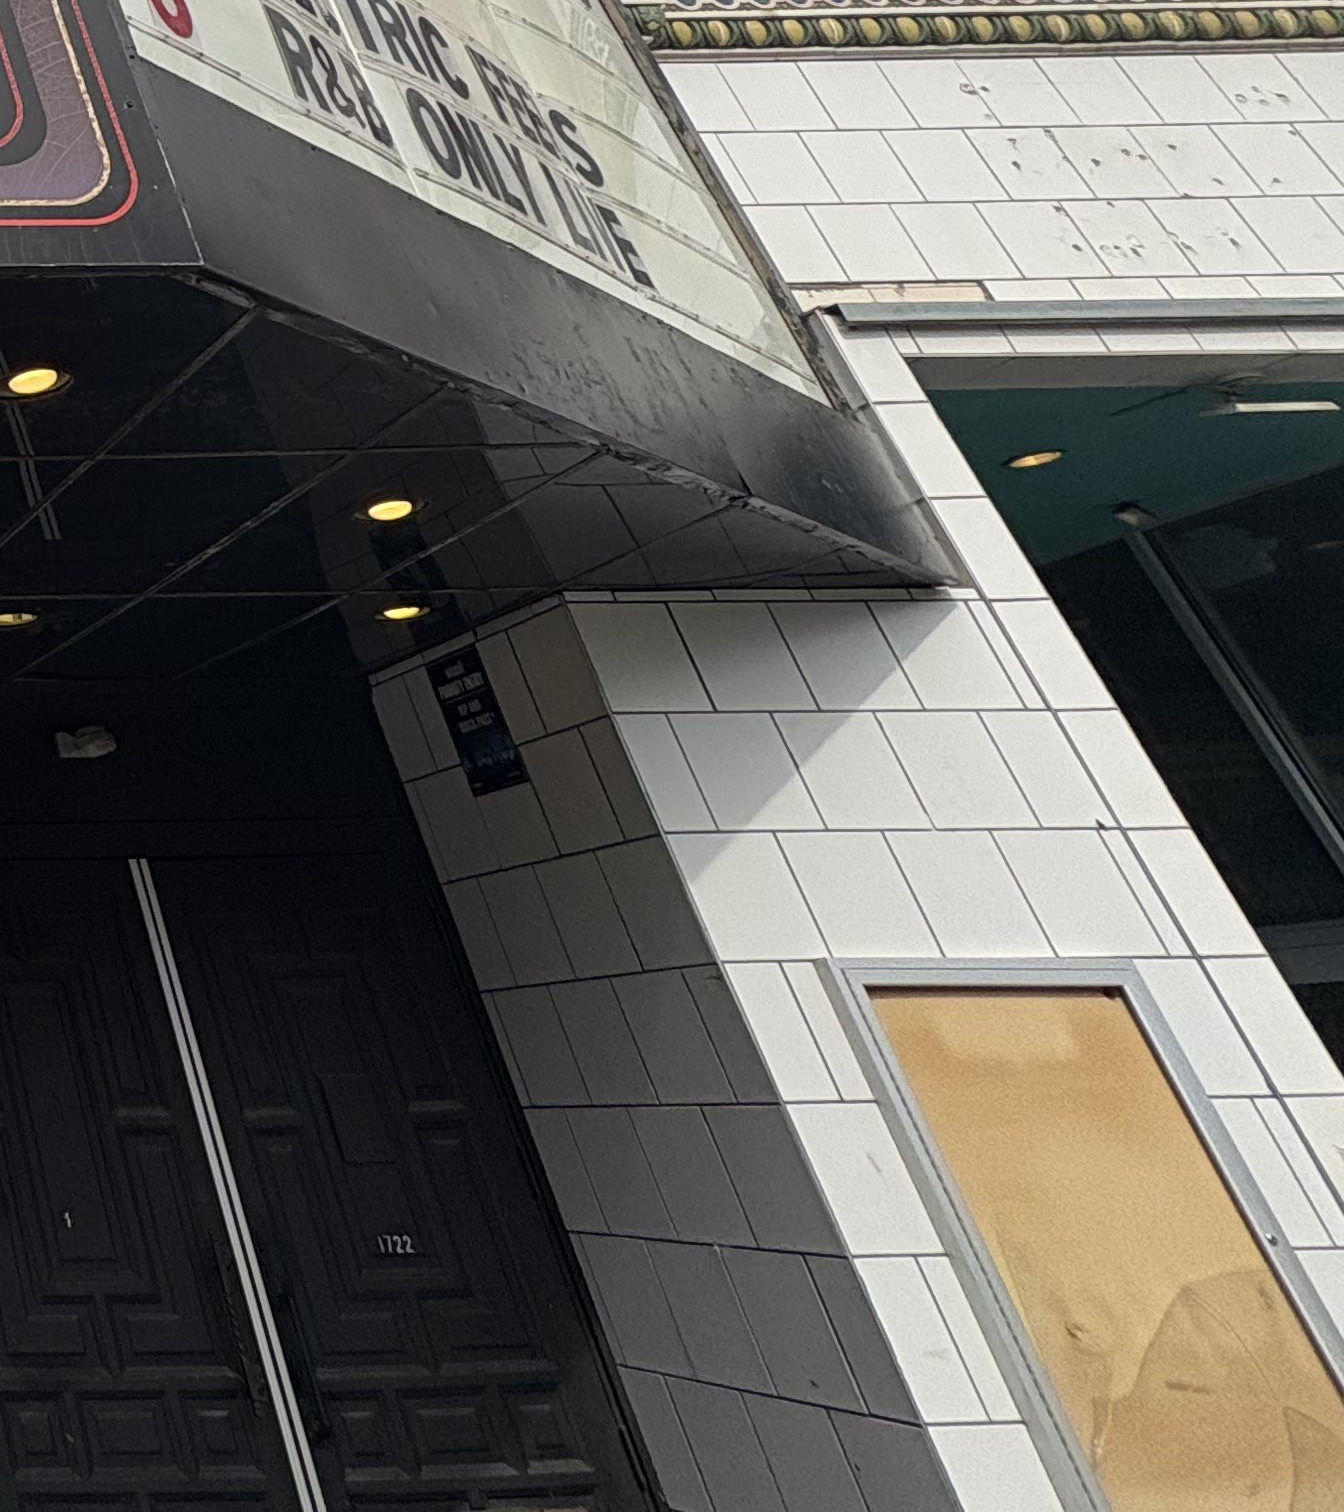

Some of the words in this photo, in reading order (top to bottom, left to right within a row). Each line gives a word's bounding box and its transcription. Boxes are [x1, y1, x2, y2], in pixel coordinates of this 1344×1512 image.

[262, 4, 394, 149] R&B
[406, 87, 547, 227] ONLY
[538, 161, 661, 294] LIVE
[377, 1234, 417, 1254] 1722
